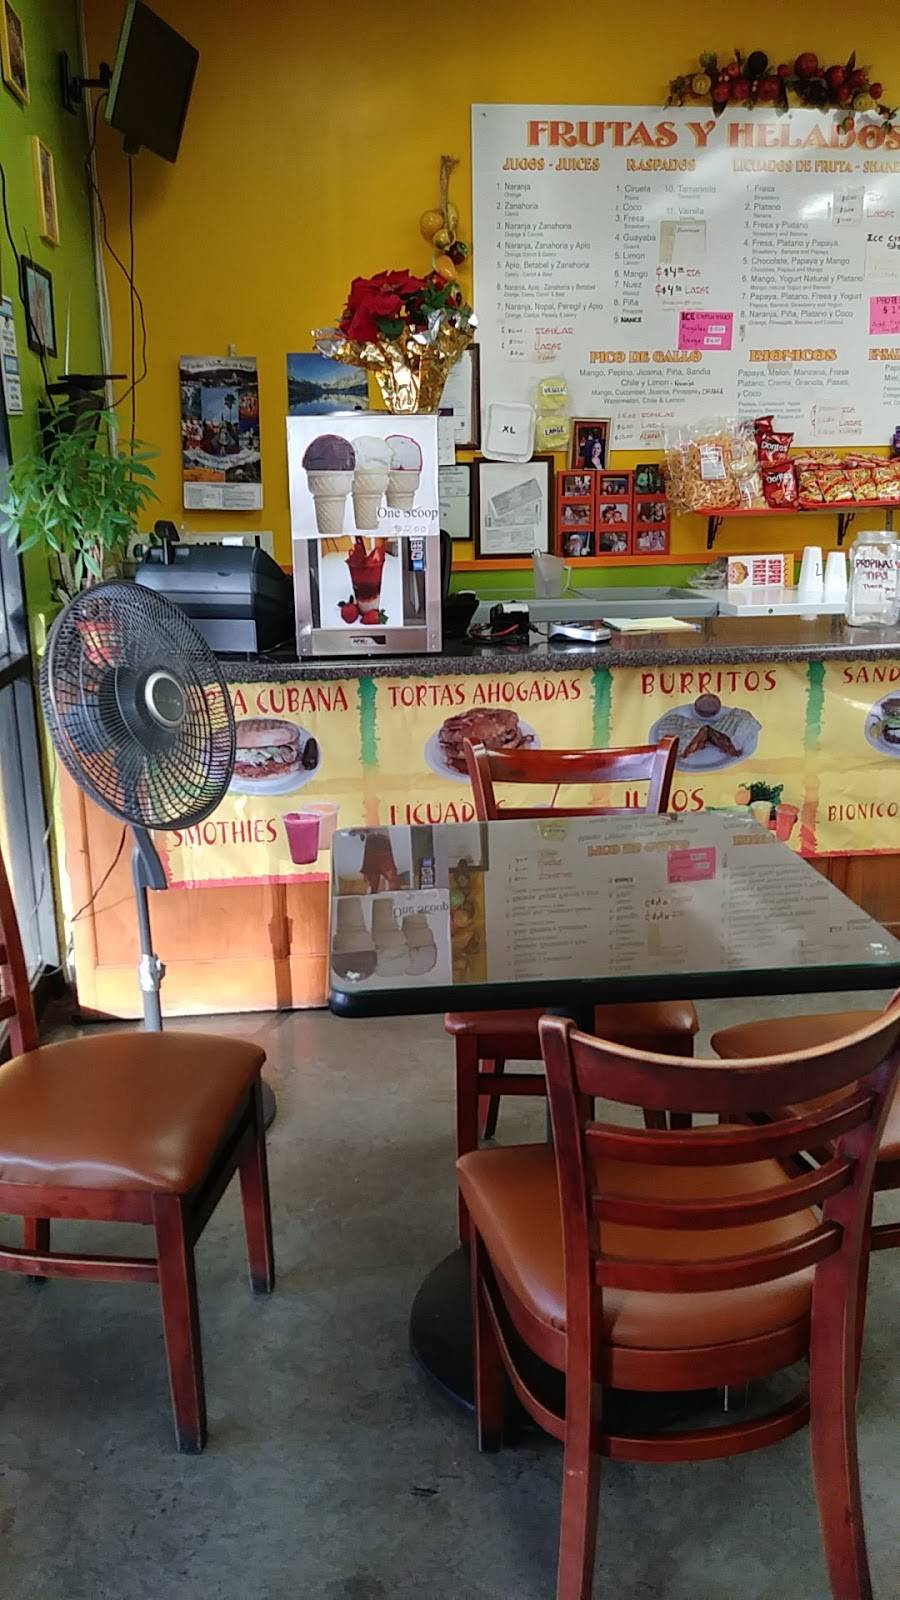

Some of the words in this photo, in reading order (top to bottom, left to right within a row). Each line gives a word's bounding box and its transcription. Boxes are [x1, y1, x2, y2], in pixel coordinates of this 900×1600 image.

[528, 120, 679, 148] FRUTAS
[685, 120, 716, 148] Y
[555, 157, 600, 171] JUICES
[626, 158, 696, 171] RASPADOS
[504, 182, 531, 192] Naranja
[754, 203, 781, 211] Platano
[504, 222, 532, 231] Naranja
[575, 242, 591, 250] Apio
[777, 239, 803, 247] Platano
[623, 270, 648, 279] Mango
[623, 280, 642, 288] Nuez
[681, 312, 695, 320] ICE
[590, 351, 625, 364] PICO
[629, 351, 650, 363] DE
[652, 350, 702, 363] GALLO
[749, 349, 837, 362] BIONICOS
[743, 390, 762, 398] Coco
[502, 425, 516, 434] XL
[761, 442, 788, 451] Doritos
[377, 507, 401, 518] One
[403, 509, 438, 520] Scoop
[856, 558, 893, 569] PROPINAS
[767, 559, 781, 584] SUPER
[864, 571, 888, 580] TIPS
[641, 669, 777, 695] BURRITOS
[388, 683, 466, 708] TORTAS
[472, 678, 582, 706] AHOGADAS
[256, 685, 349, 715] CUBANA
[172, 817, 277, 848] SMOTHIES
